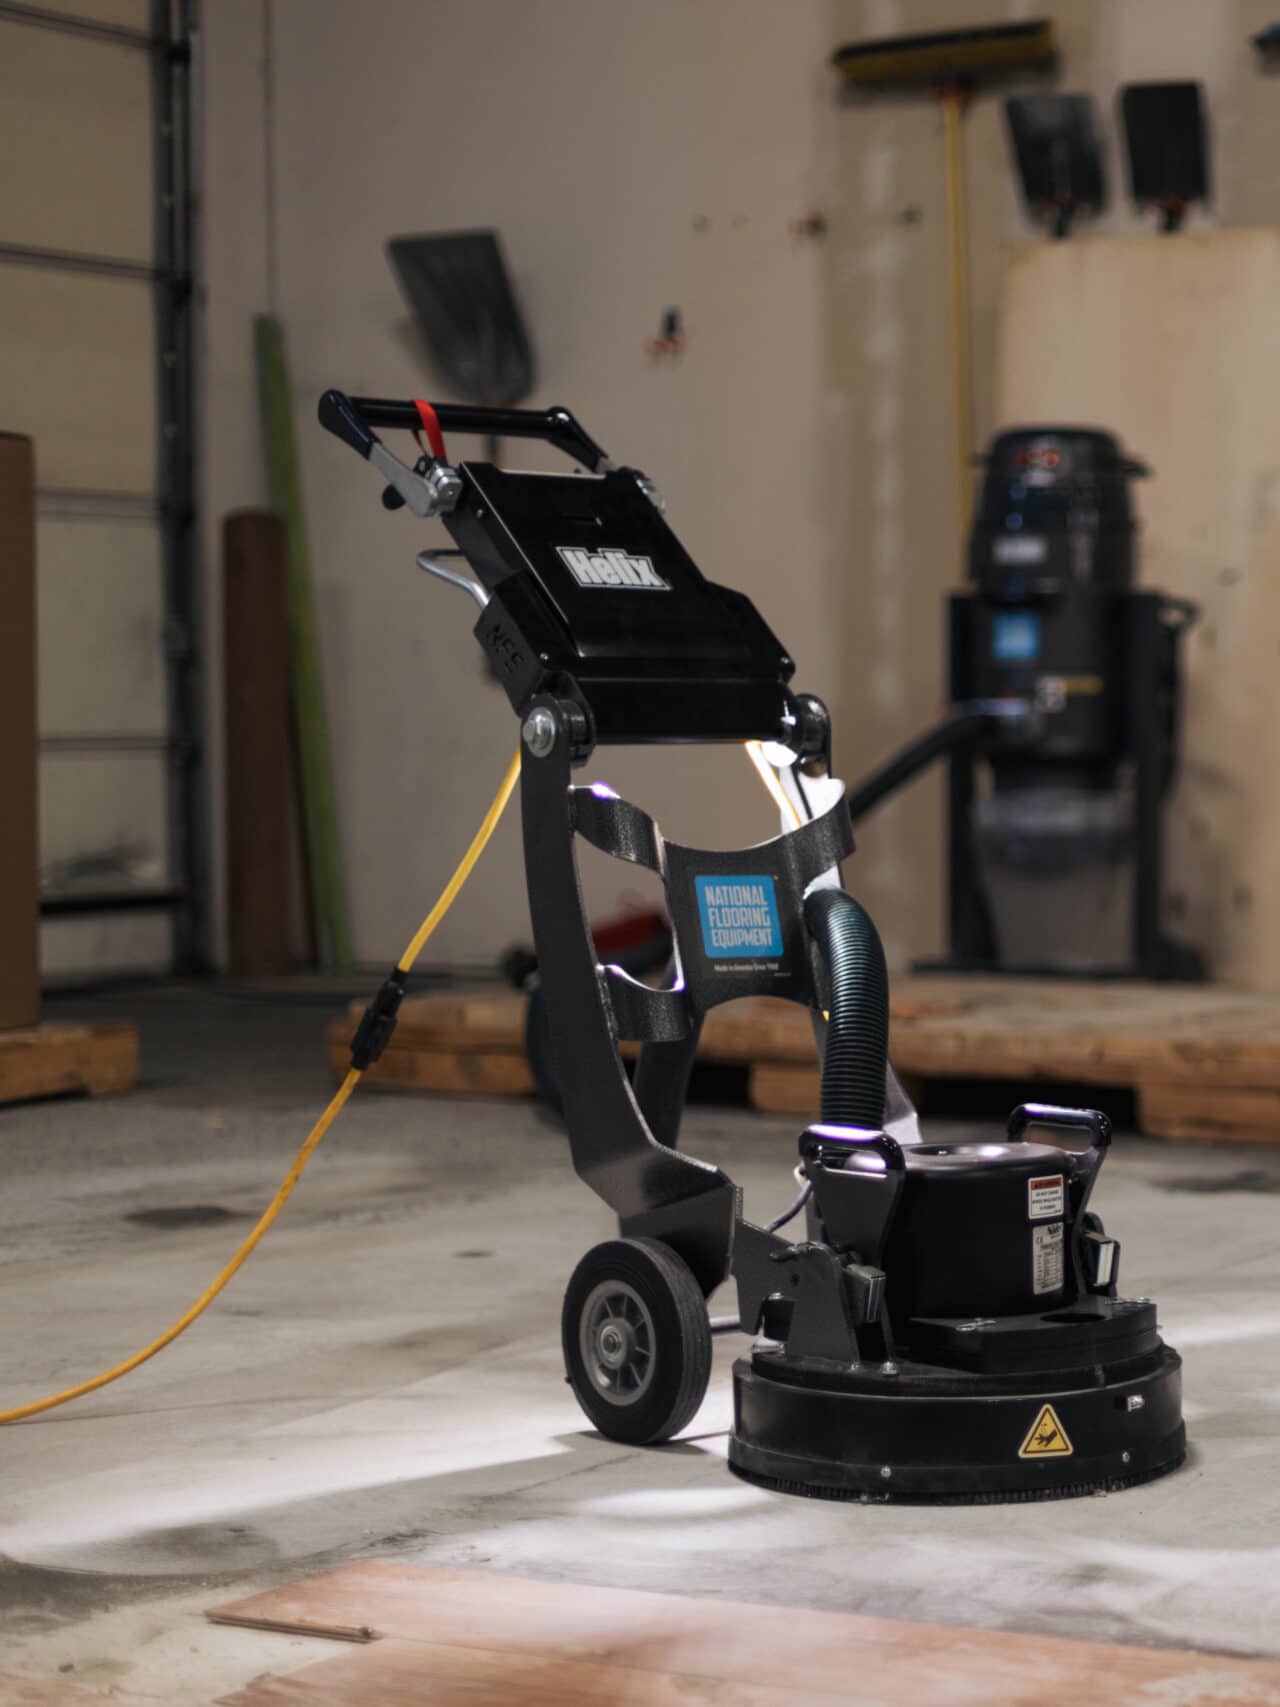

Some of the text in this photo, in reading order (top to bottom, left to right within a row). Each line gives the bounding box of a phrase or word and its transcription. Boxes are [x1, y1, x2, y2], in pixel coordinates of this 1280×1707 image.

[560, 549, 664, 586] Helix
[705, 885, 769, 906] NATIONAL
[708, 906, 771, 928] FLOORING
[712, 927, 773, 949] EQUIPMENT
